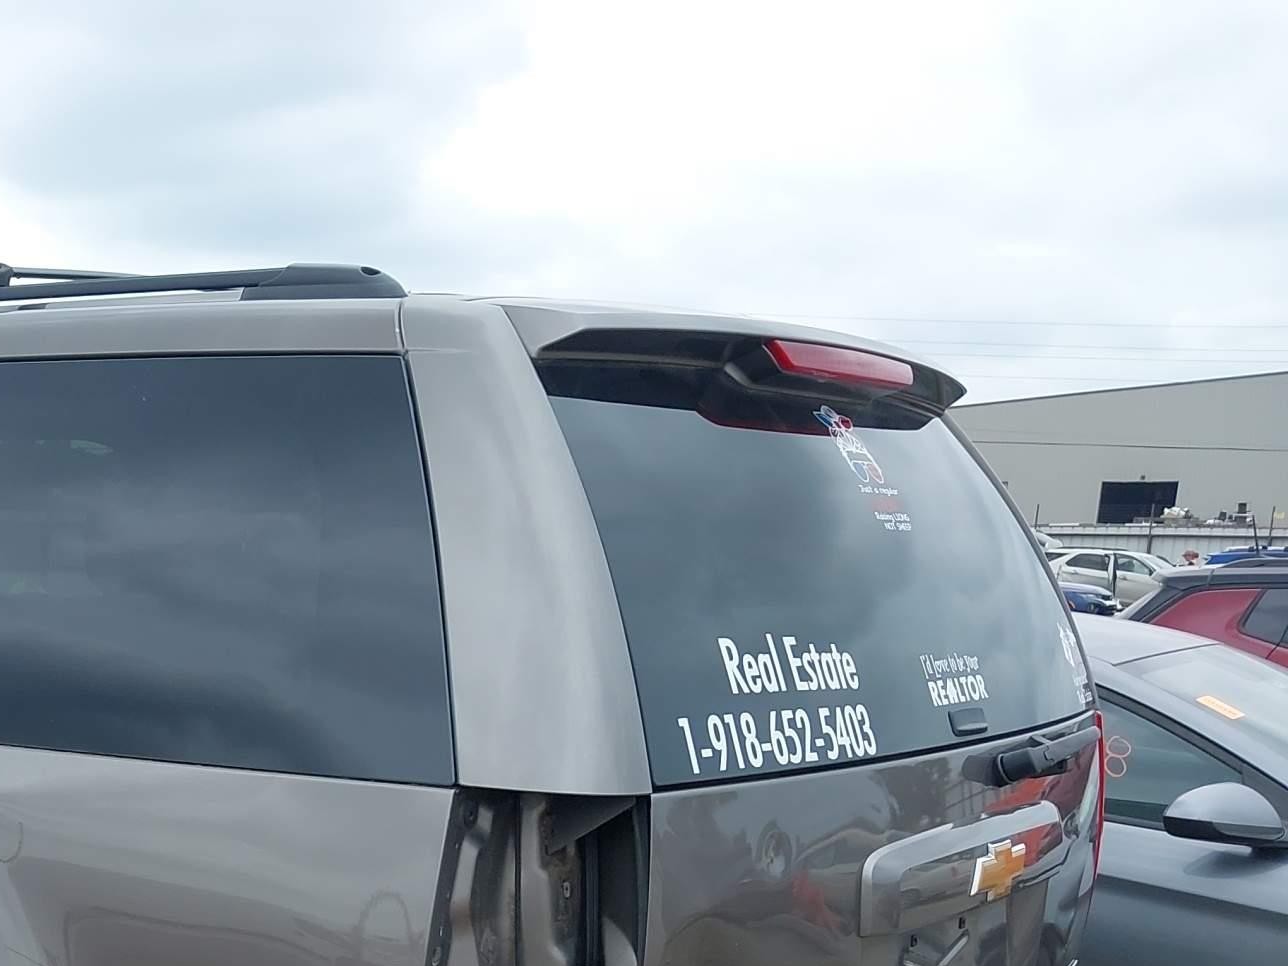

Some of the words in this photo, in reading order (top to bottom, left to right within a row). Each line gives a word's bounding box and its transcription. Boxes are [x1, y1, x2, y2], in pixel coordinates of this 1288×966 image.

[718, 633, 788, 695] Real
[782, 636, 860, 691] Estate
[928, 674, 989, 707] REALTOR
[677, 704, 877, 774] 1-918-652-5403
